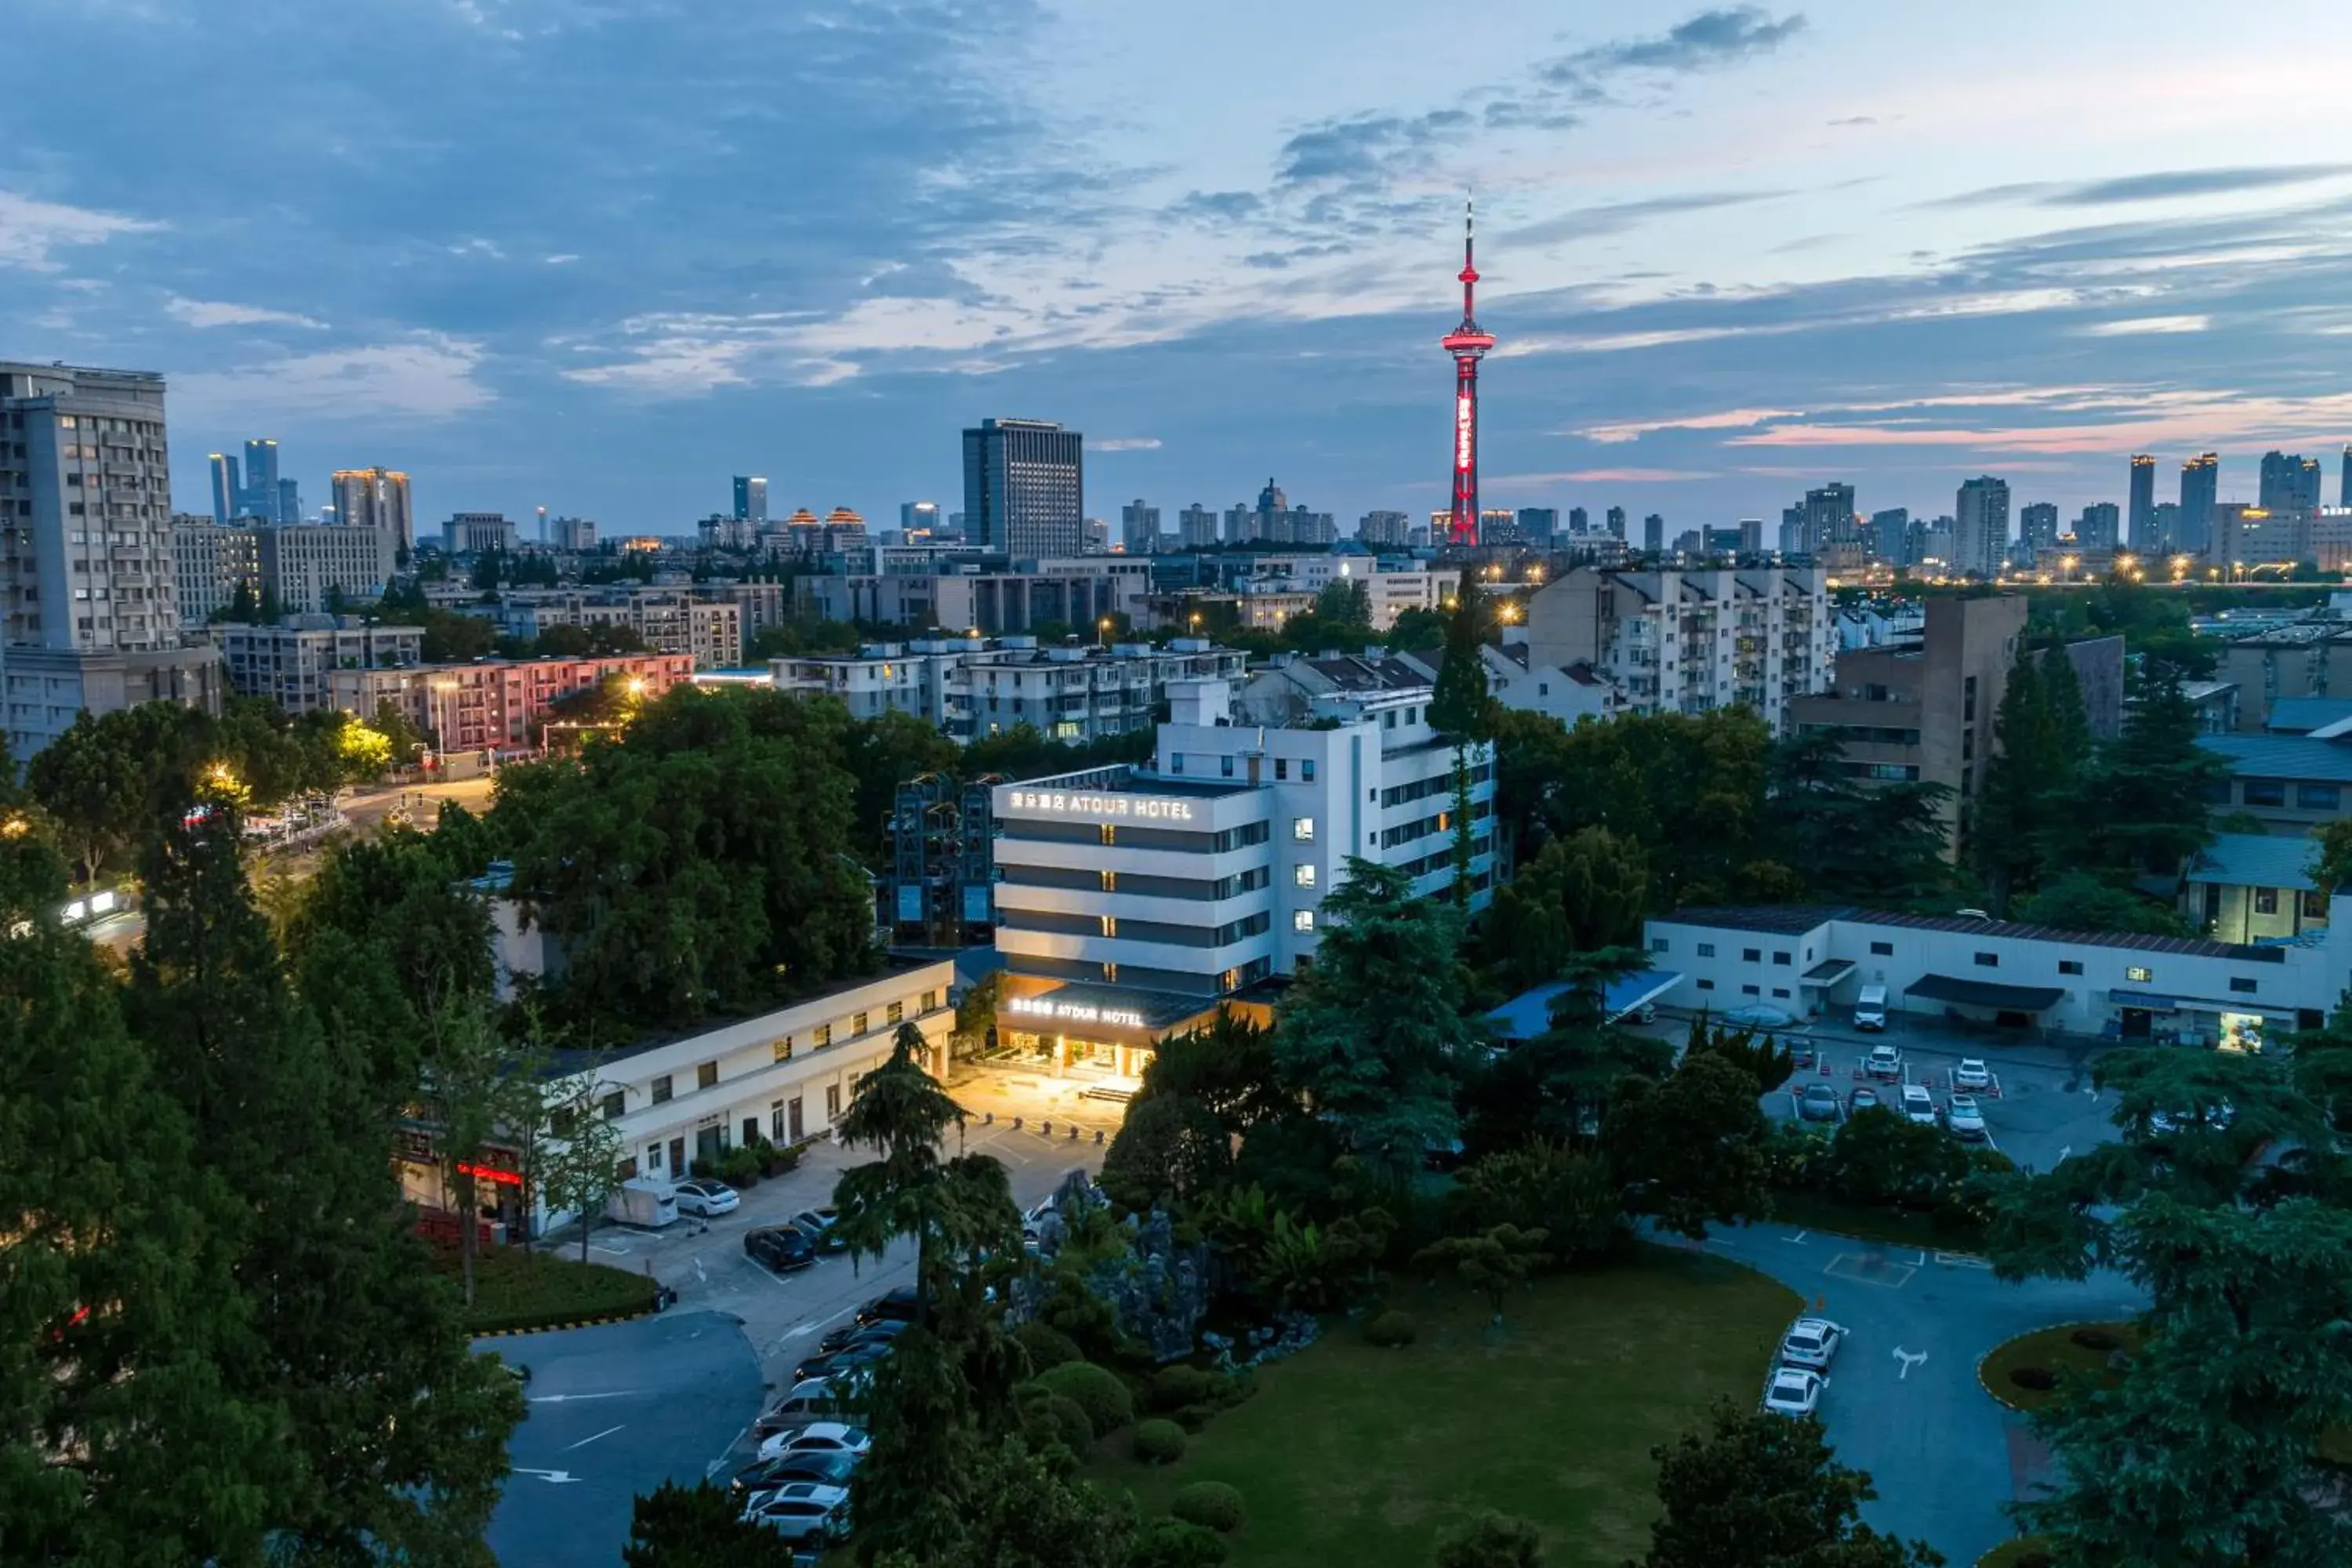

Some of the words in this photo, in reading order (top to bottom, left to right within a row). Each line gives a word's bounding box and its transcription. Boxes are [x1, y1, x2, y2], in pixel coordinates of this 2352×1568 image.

[1069, 796, 1128, 815] ATOUR
[1134, 800, 1192, 820] HOTEL
[1102, 1010, 1144, 1027] HOTEL
